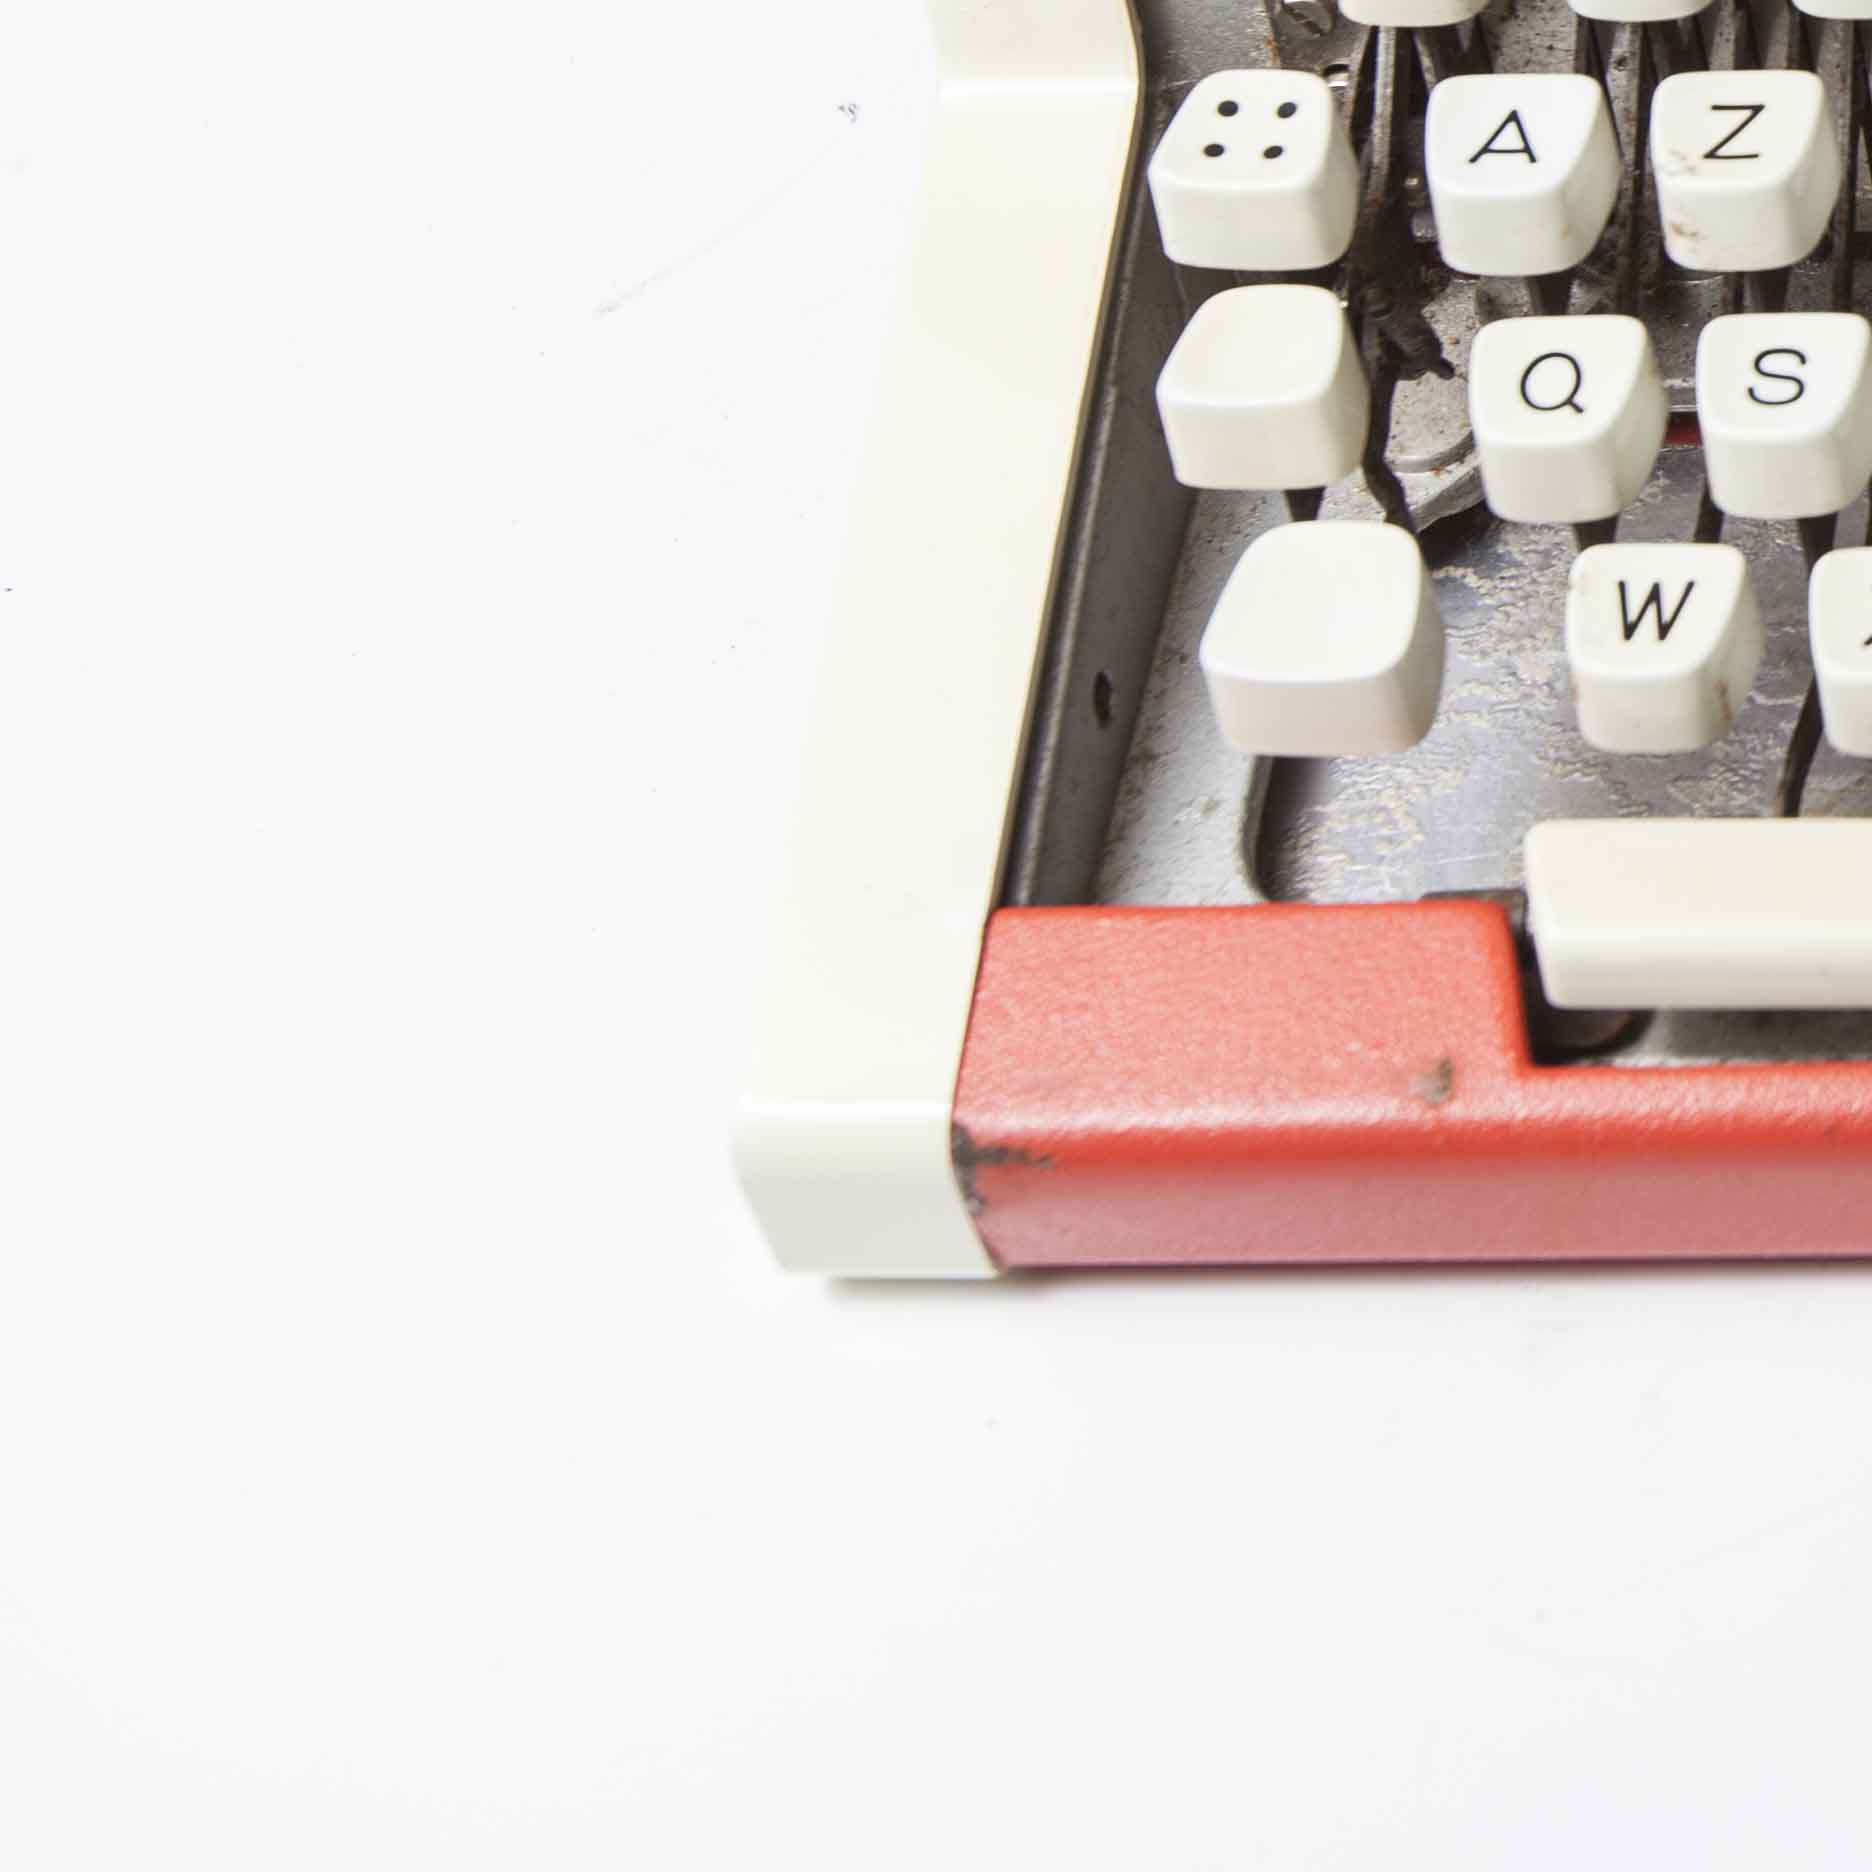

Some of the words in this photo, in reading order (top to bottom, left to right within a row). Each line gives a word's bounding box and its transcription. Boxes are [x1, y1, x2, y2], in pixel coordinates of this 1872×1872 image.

[1468, 109, 1537, 164] A
[1702, 103, 1766, 160] Z
[1519, 351, 1585, 414] Q
[1747, 347, 1807, 406] S
[1617, 580, 1695, 641] W
